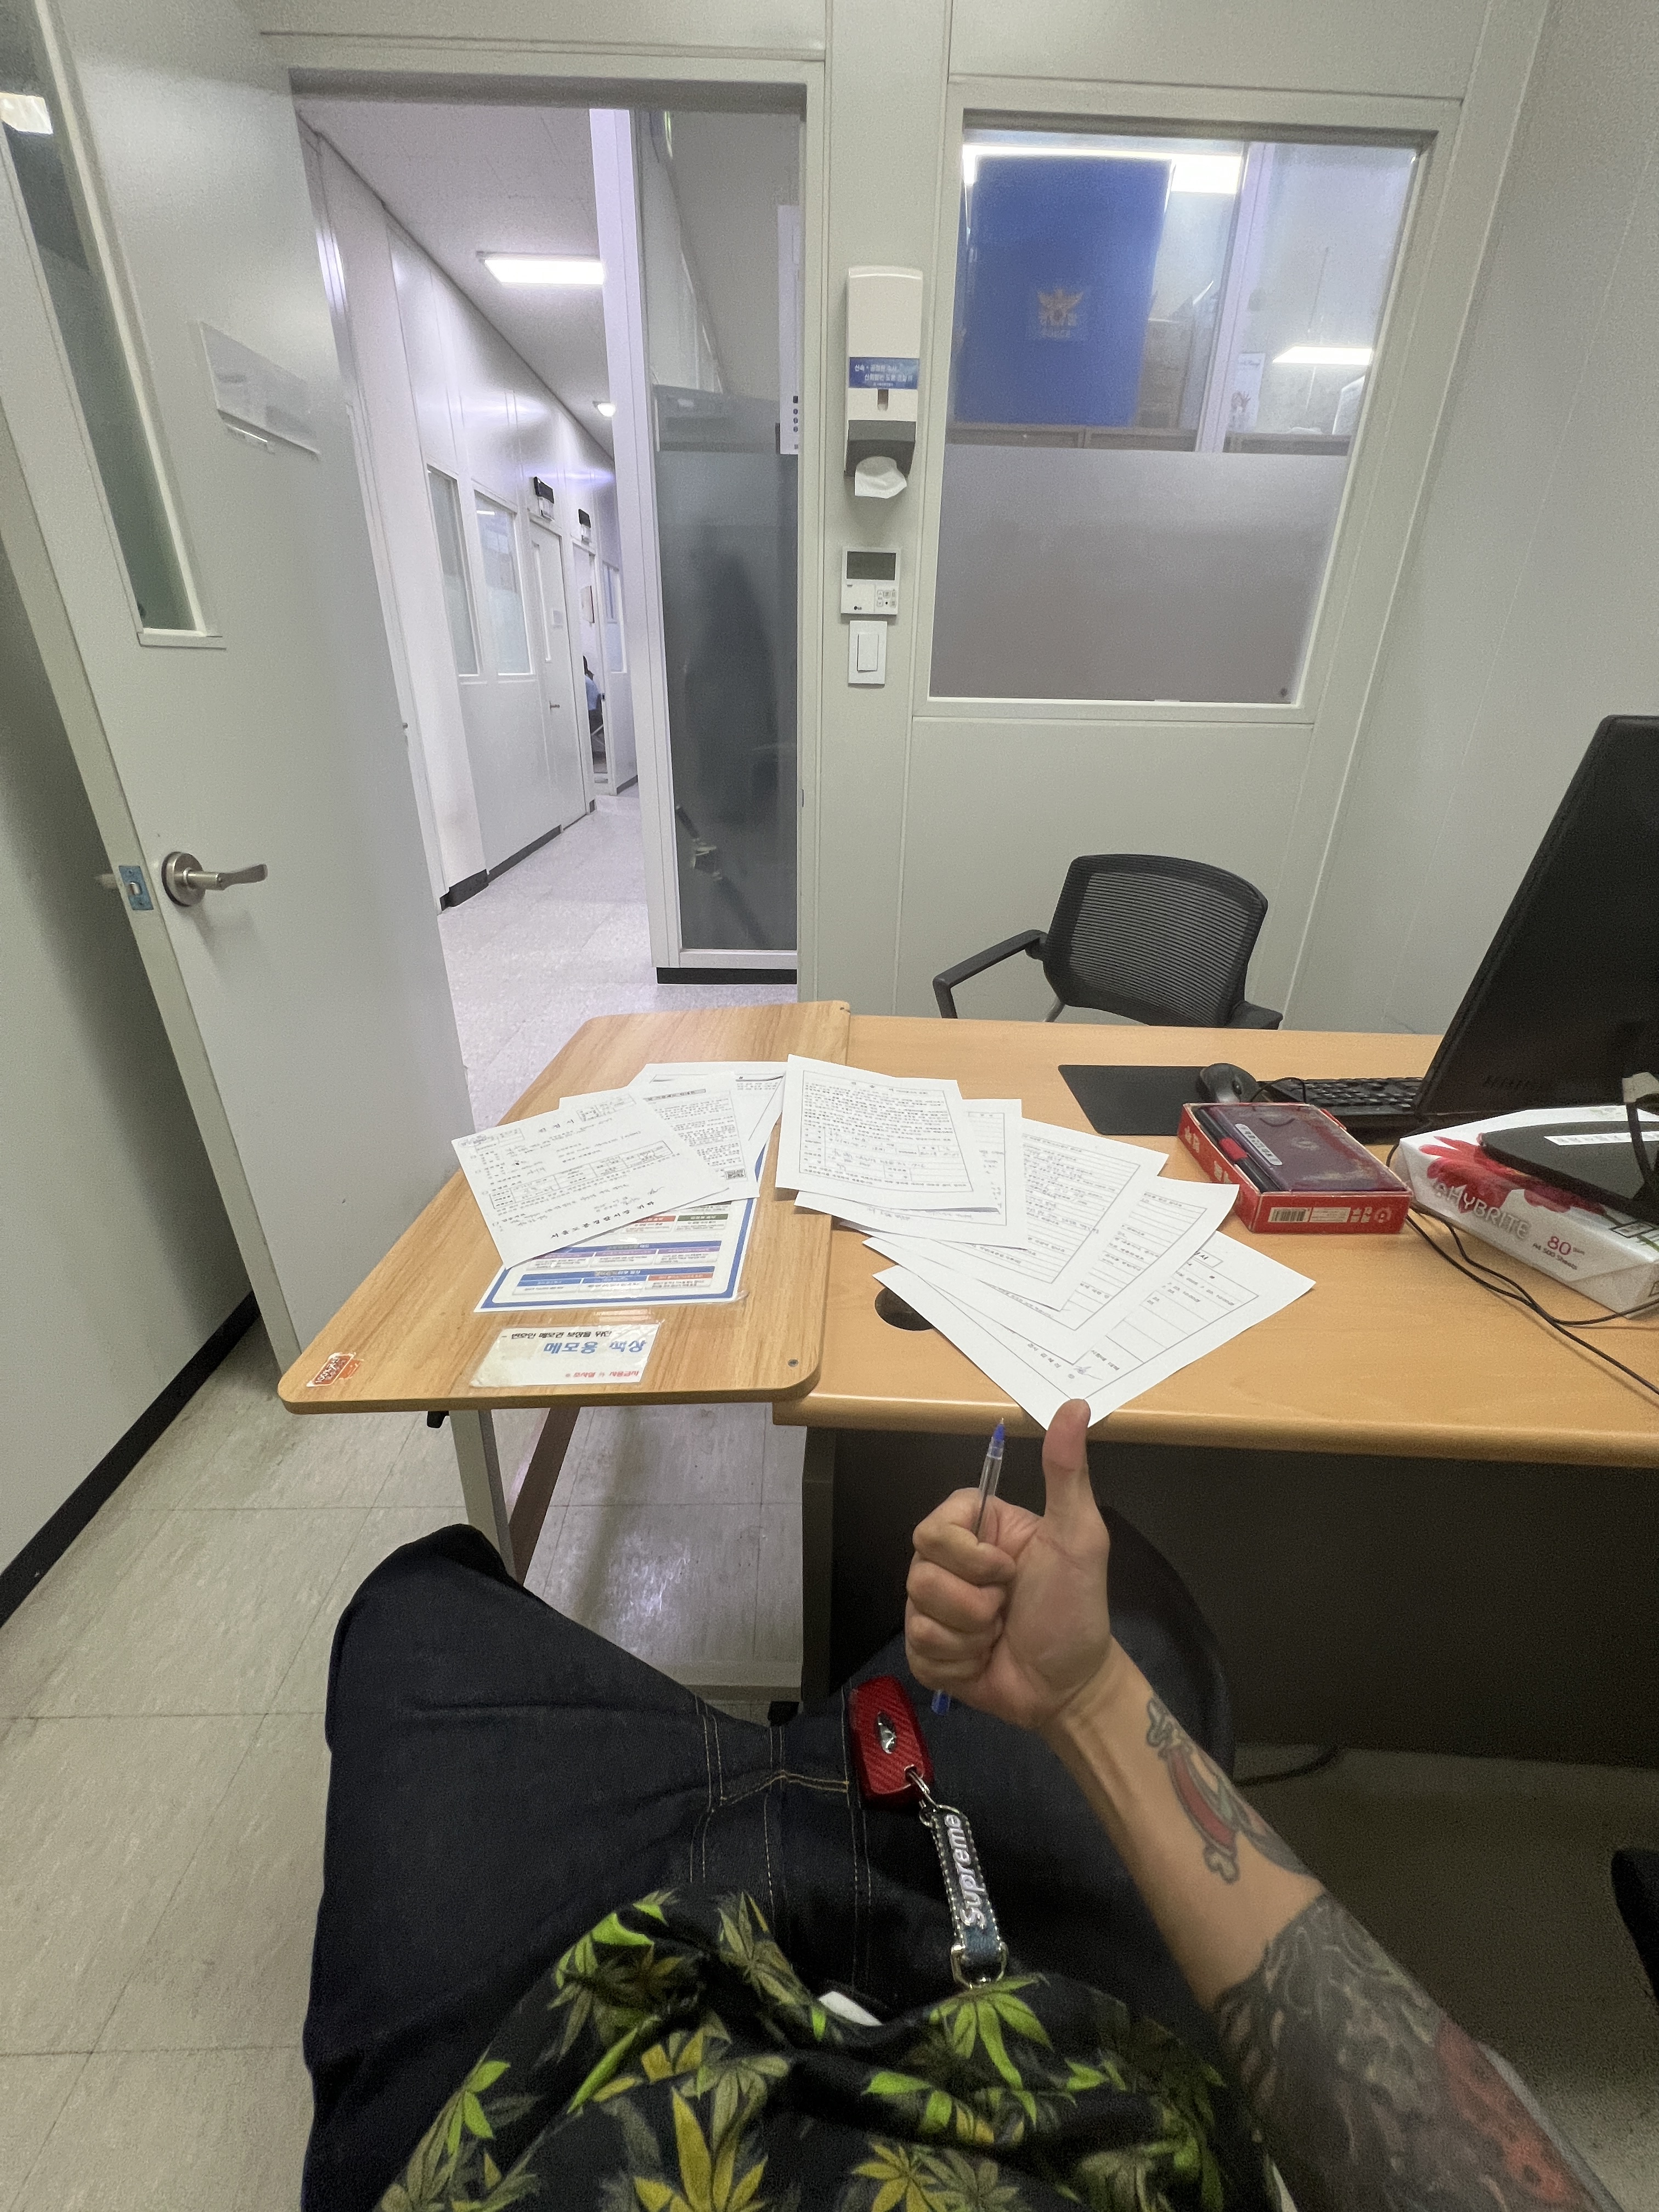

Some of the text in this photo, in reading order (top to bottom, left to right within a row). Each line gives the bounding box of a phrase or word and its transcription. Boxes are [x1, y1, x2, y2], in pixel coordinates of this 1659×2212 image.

[1548, 1236, 1571, 1255] 80
[543, 1341, 599, 1354] 메모용
[945, 1814, 986, 1929] Supreme
